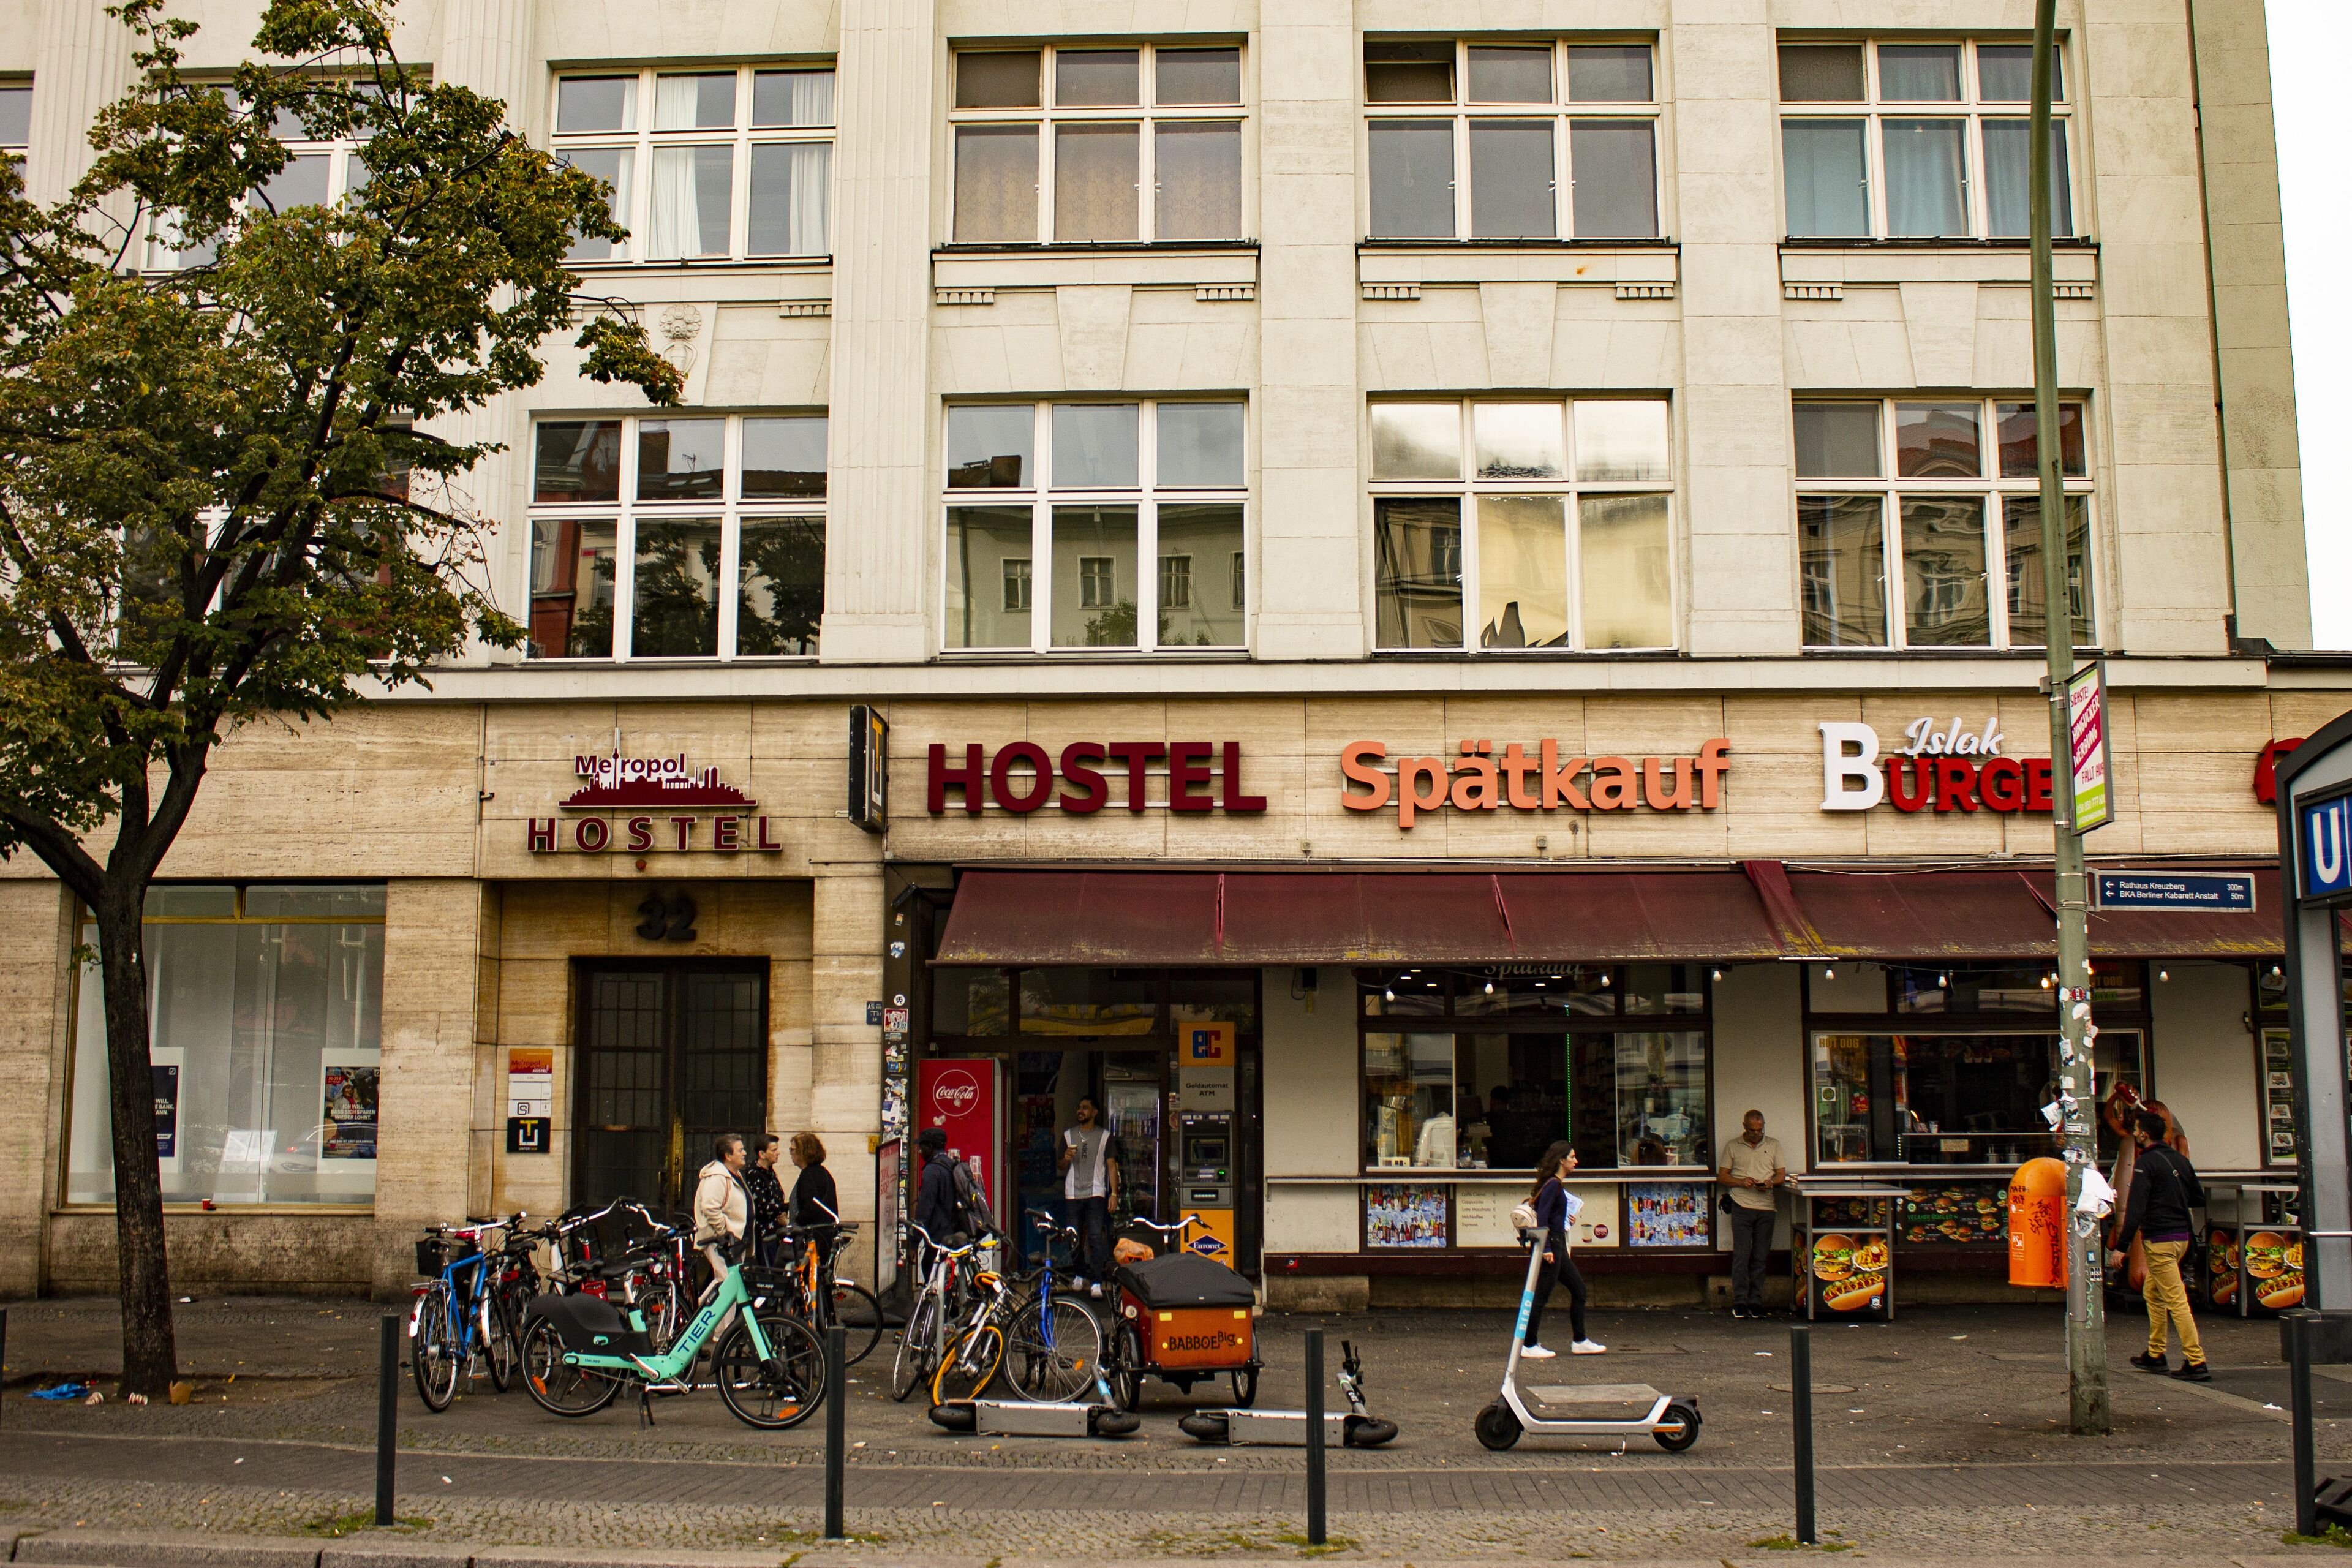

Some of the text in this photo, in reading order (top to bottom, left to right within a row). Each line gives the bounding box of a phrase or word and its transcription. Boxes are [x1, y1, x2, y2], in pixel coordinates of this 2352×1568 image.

[1902, 717, 2005, 756] Islak
[2073, 723, 2098, 768] WERBUNG
[927, 741, 1267, 813] HOSTEL
[1340, 738, 1730, 828] Spätkauf
[1817, 722, 2054, 812] BURGE
[527, 816, 782, 853] HOSTEL
[2312, 807, 2341, 884] U
[636, 899, 697, 941] 32
[1819, 1038, 1860, 1049] HOT DOG
[677, 1310, 716, 1352] TIER
[1519, 1300, 1532, 1332] BIRD
[1169, 1330, 1236, 1351] BABBOE Big
